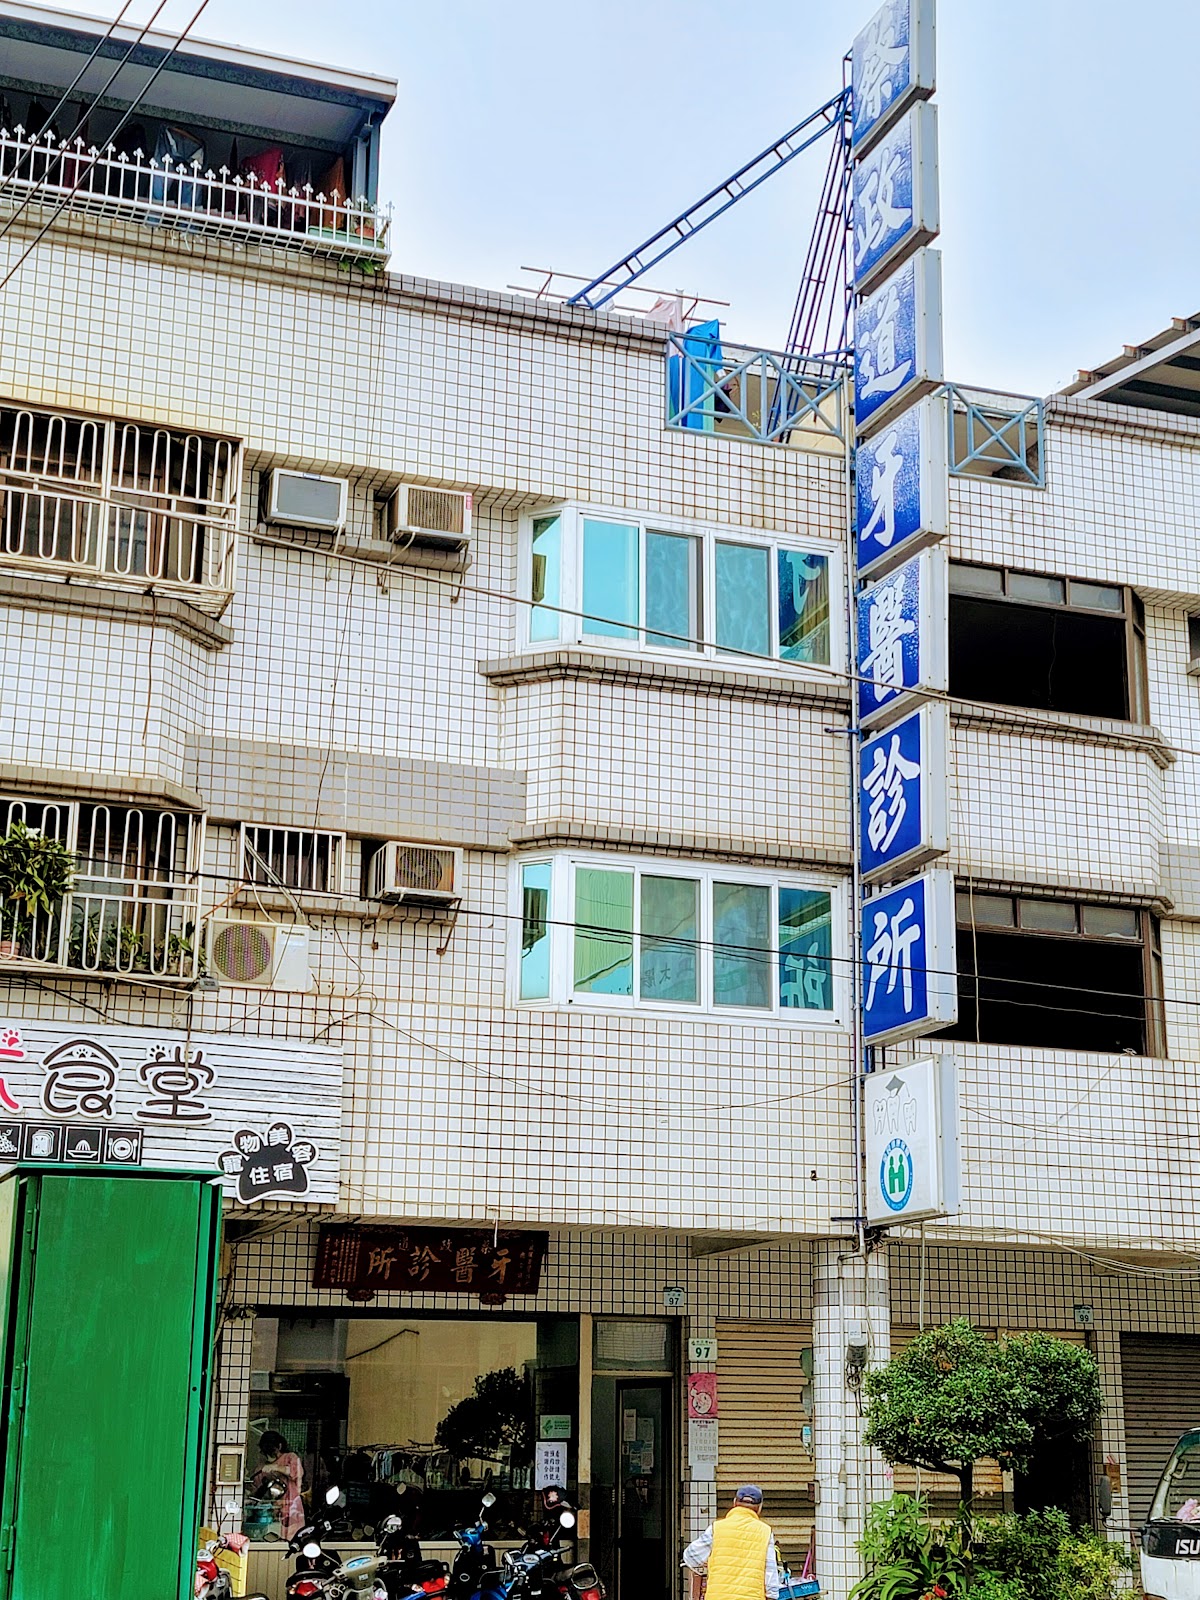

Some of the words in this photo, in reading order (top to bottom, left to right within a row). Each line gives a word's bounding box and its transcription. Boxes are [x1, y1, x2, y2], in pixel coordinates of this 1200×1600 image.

[222, 1128, 311, 1173] 寵物美容
[249, 1163, 294, 1185] 住宿
[367, 1245, 512, 1284] 牙醫診所
[669, 1297, 680, 1305] 97
[1079, 1314, 1089, 1322] 99
[695, 1347, 710, 1358] 97
